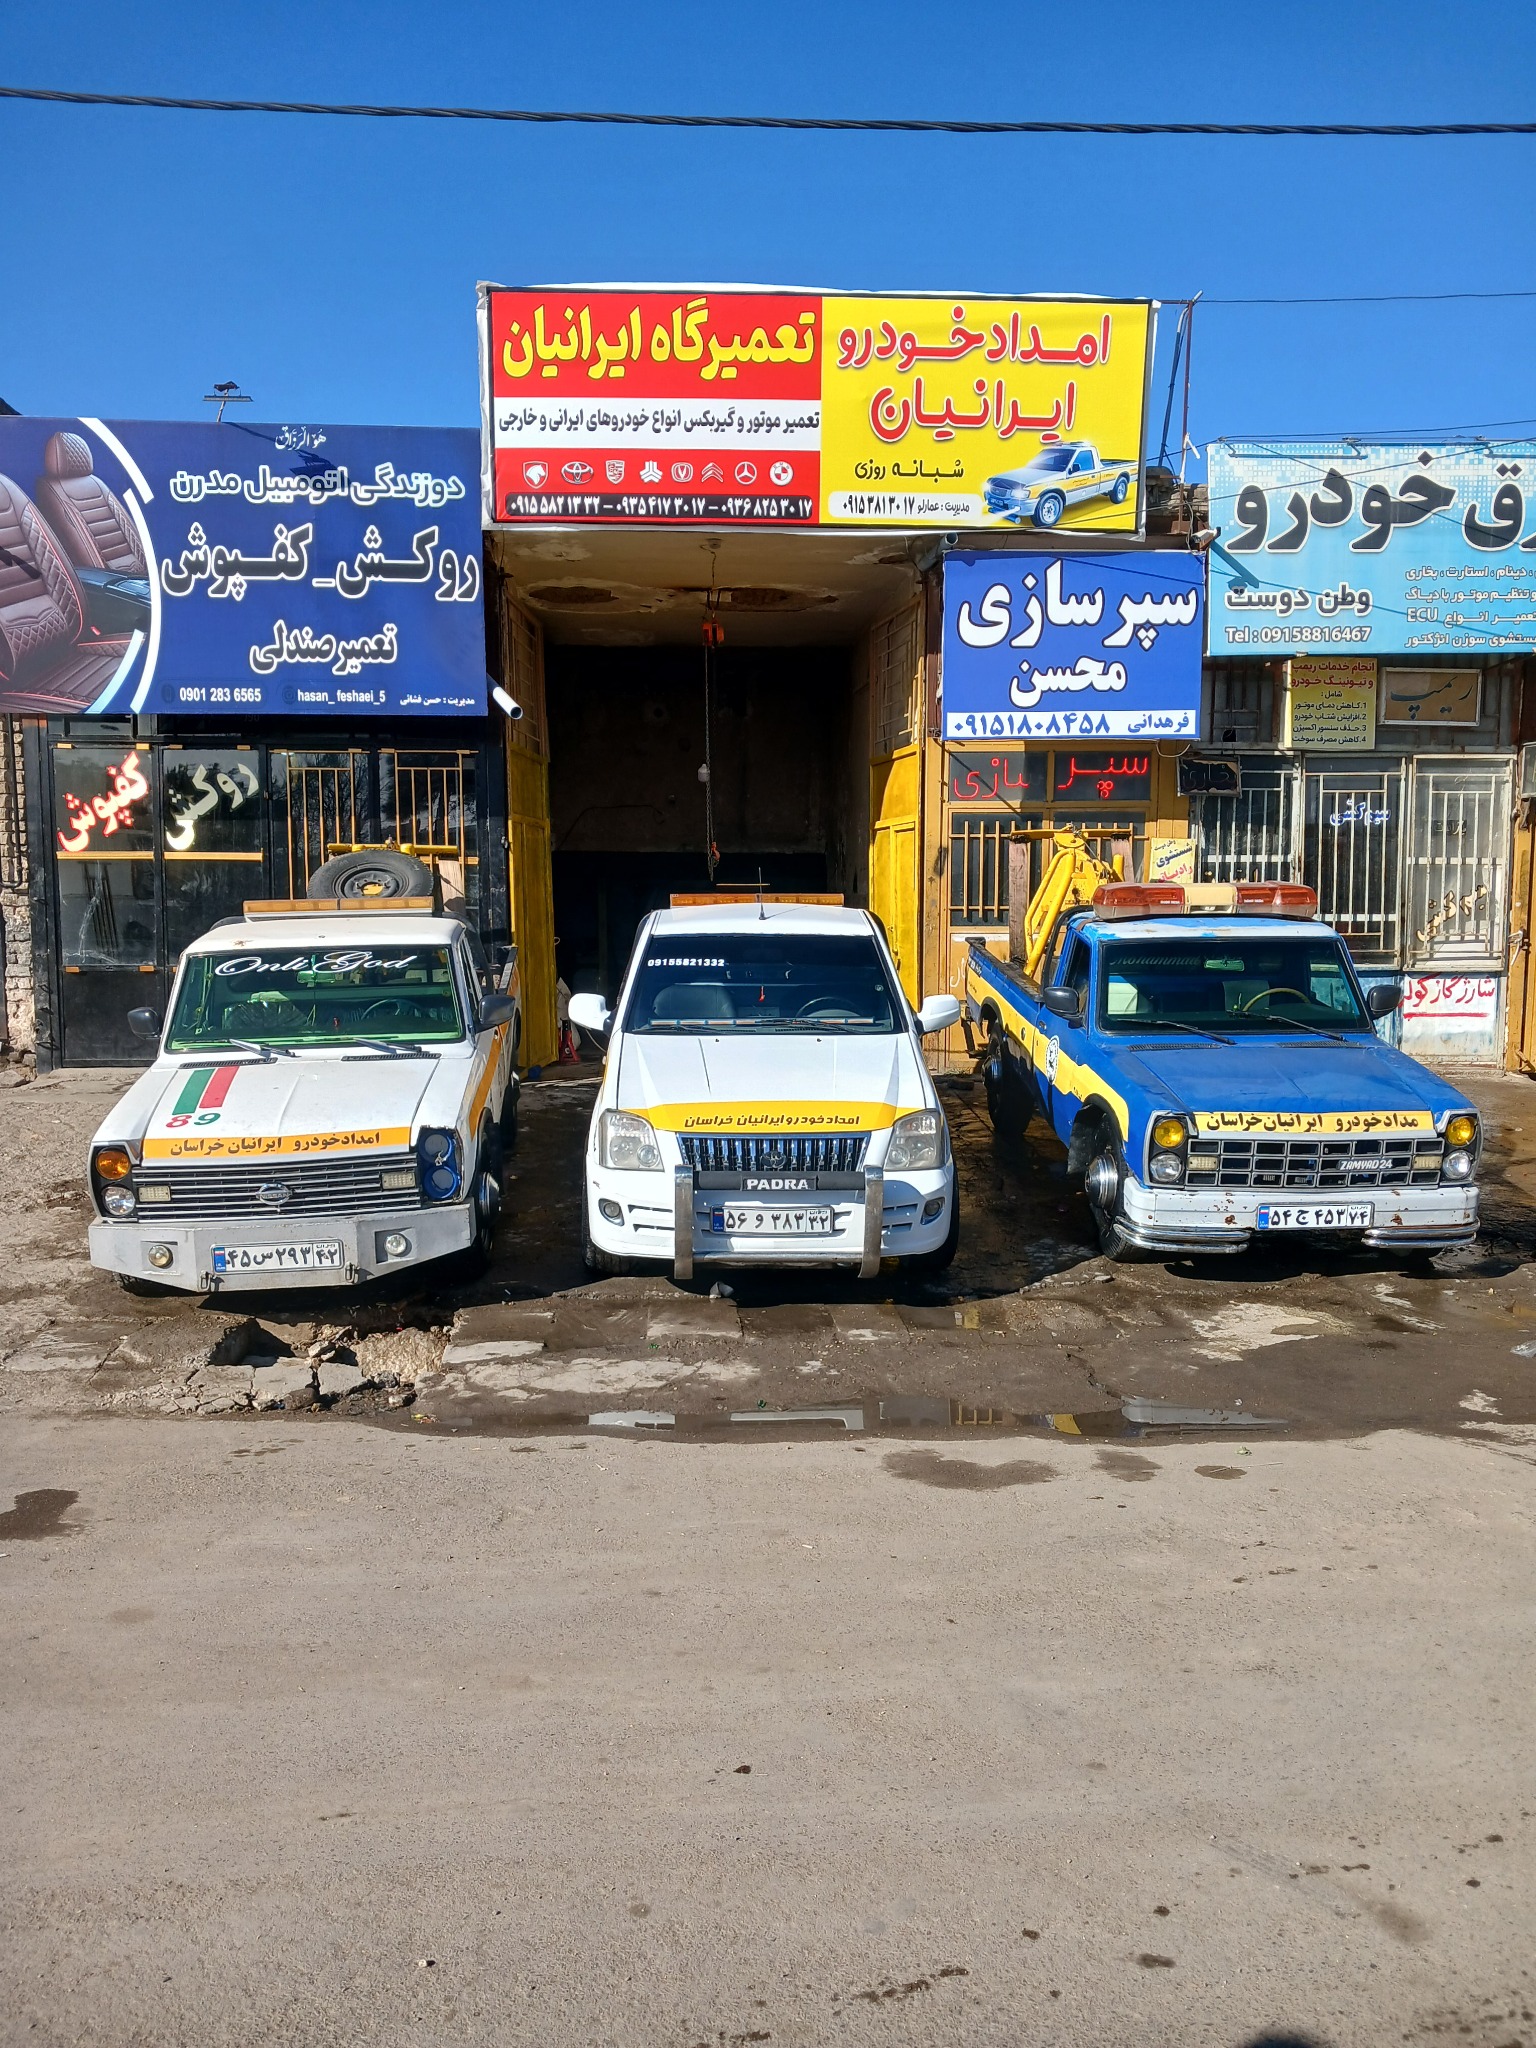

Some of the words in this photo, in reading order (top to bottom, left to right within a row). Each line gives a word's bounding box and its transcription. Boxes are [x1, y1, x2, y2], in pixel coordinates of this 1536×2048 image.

[502, 304, 641, 380] ایرانیان
[650, 297, 815, 380] تعمیرگاه
[499, 408, 537, 432] خارجی
[549, 408, 583, 432] ایرانی
[586, 407, 650, 432] خودروهای
[652, 408, 681, 433] انواع
[684, 407, 735, 433] گیربکس
[870, 377, 1076, 442] ایرانیان
[539, 416, 547, 432] و
[737, 416, 745, 433] و
[747, 411, 780, 434] موتور
[783, 410, 820, 433] تعمیر
[854, 459, 886, 480] روزی
[892, 459, 964, 483] شبانه
[170, 469, 241, 502] مدرن
[244, 465, 351, 502] اتومبیل
[351, 462, 465, 508] دوزندگی
[945, 501, 970, 516] مدیریت
[1224, 451, 1458, 553] خودرو
[1405, 566, 1438, 580] بخاری
[956, 557, 1105, 648] سازی
[1224, 586, 1312, 617] دوست
[1315, 581, 1374, 617] وطن
[1450, 589, 1489, 603] موتور
[1101, 586, 1198, 651] سپر
[1407, 607, 1438, 622] ECU
[1225, 625, 1250, 643] Tel
[1261, 625, 1372, 643] 09158816467
[1405, 632, 1449, 648] انژکتور
[249, 620, 337, 674] صندلی
[334, 622, 397, 676] تعمیر
[1292, 664, 1317, 673] ریمپ
[1319, 661, 1350, 672] خدمات
[1351, 662, 1375, 674] انجام
[1009, 655, 1128, 709] محسن
[1291, 677, 1321, 688] خودرو
[1324, 675, 1367, 688] تیونینگ
[179, 686, 206, 702] 0901
[210, 686, 231, 702] 283
[234, 687, 261, 702] 6565
[421, 695, 441, 706] حسن
[447, 695, 475, 706] مدیریت
[1325, 691, 1343, 699] شامل
[1294, 702, 1314, 711] موتور
[1294, 713, 1313, 722] خودرو
[954, 712, 1110, 736] ۰۹۱۵۱۸۰۸۴۵۸
[1057, 757, 1148, 799] سپر
[57, 751, 148, 852] کفپوش
[165, 763, 259, 850] روکش
[313, 951, 418, 974] God
[647, 958, 725, 967] 09155821332
[1455, 976, 1495, 1004] شارژ
[684, 1115, 733, 1127] خراسان
[737, 1114, 784, 1126] ایرانیان
[1206, 1112, 1262, 1131] خراسان
[1263, 1113, 1323, 1132] ایرانیان
[170, 1138, 224, 1156] خراسان
[228, 1137, 282, 1154] ایرانیان
[747, 1179, 809, 1190] PADRA
